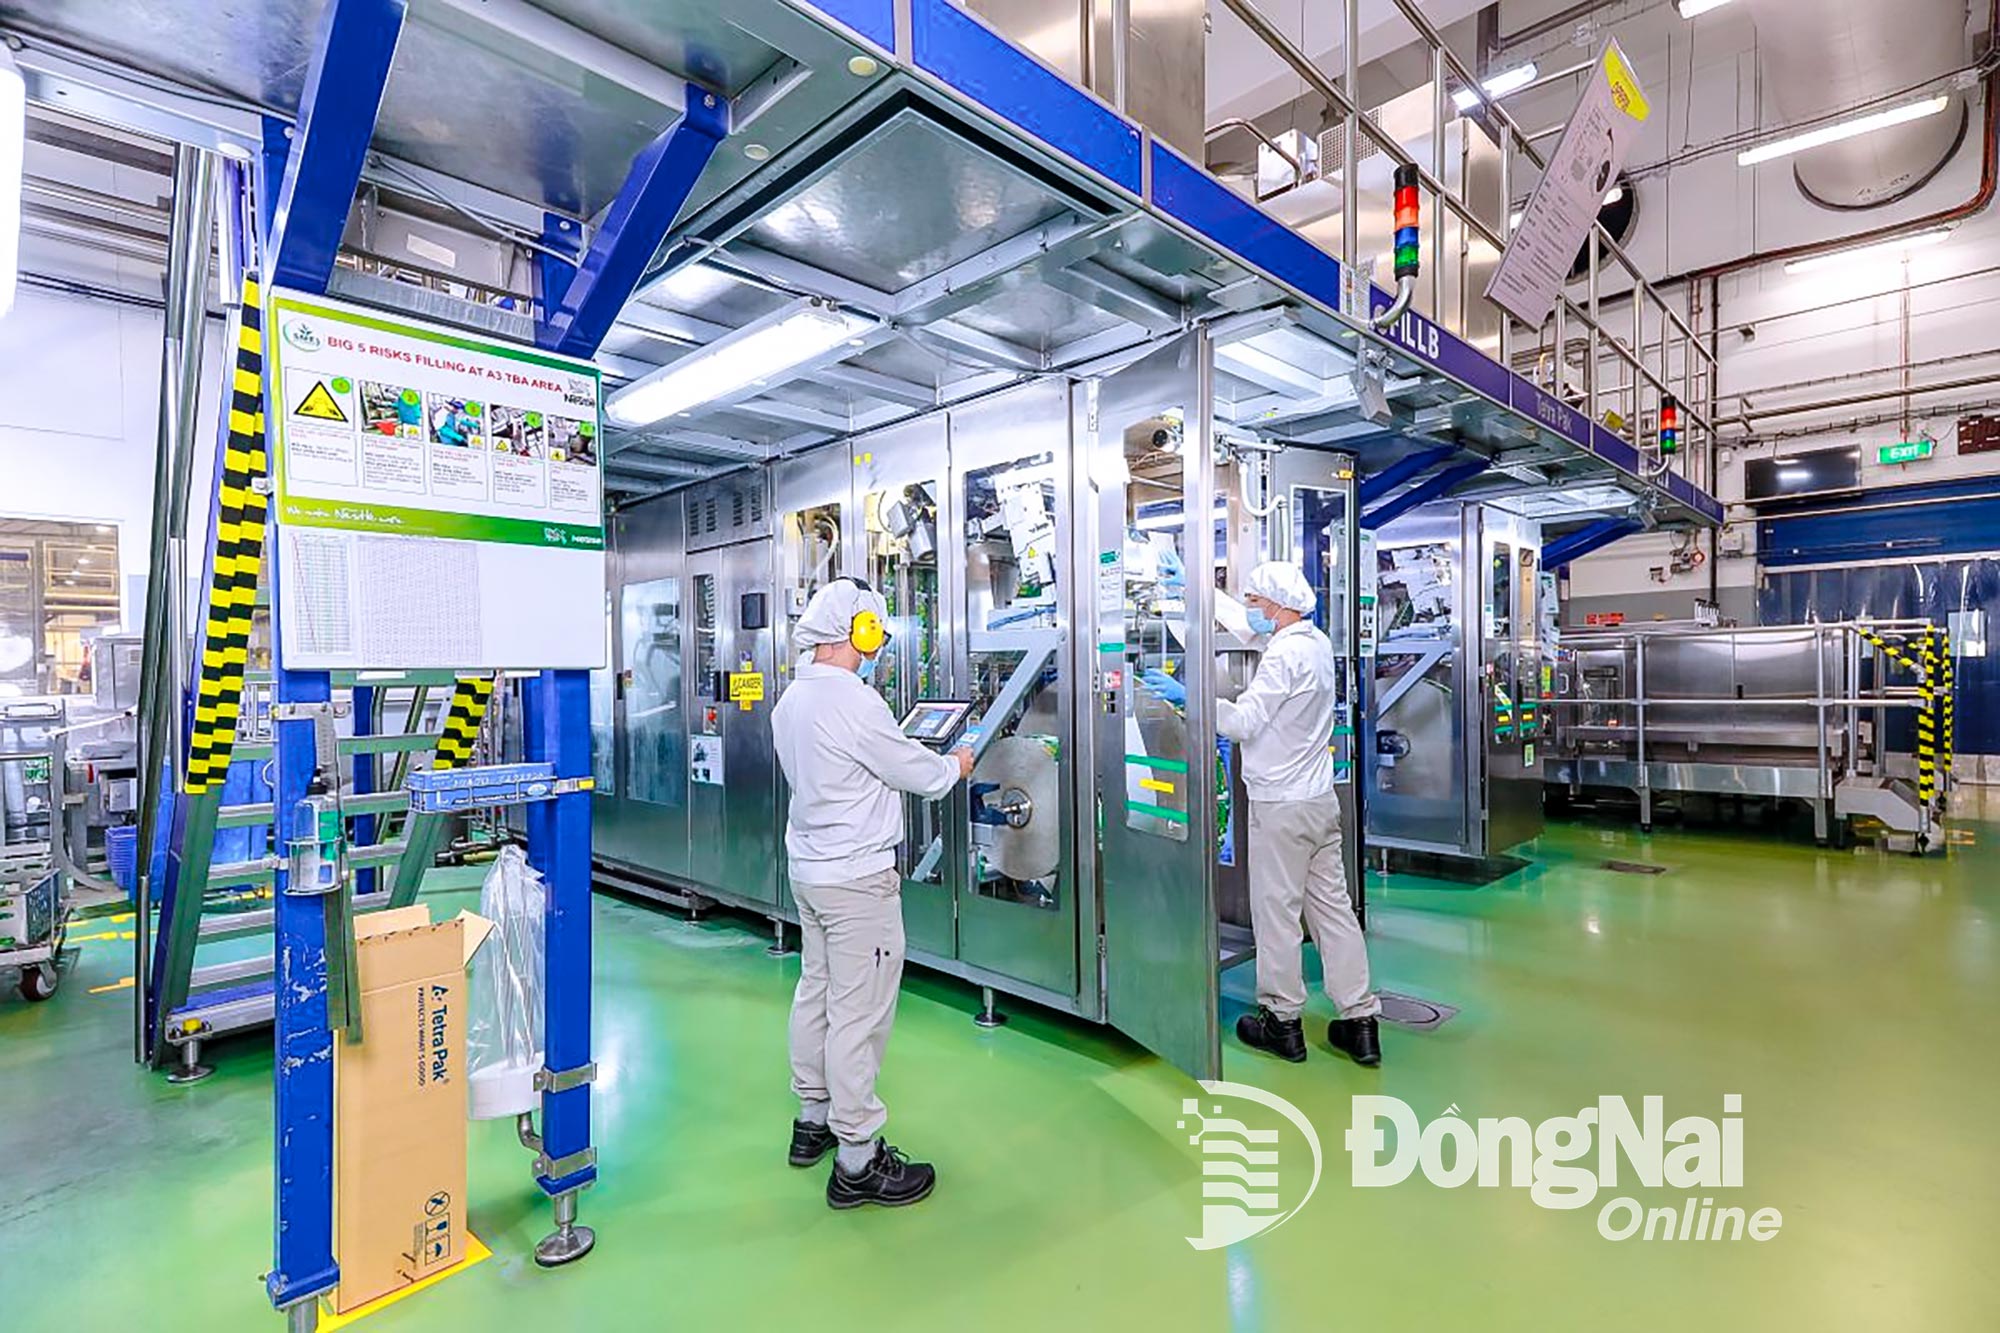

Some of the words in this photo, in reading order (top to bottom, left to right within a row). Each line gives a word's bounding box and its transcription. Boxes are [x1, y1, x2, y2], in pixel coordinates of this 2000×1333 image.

[327, 336, 353, 351] BIG
[358, 343, 366, 353] 5
[369, 345, 412, 363] RISKS
[415, 354, 465, 373] FILLING
[468, 366, 484, 377] AT
[505, 373, 529, 386] TBA
[531, 379, 563, 393] AREA
[1890, 446, 1918, 459] EXIT
[432, 1004, 448, 1047] Tetra
